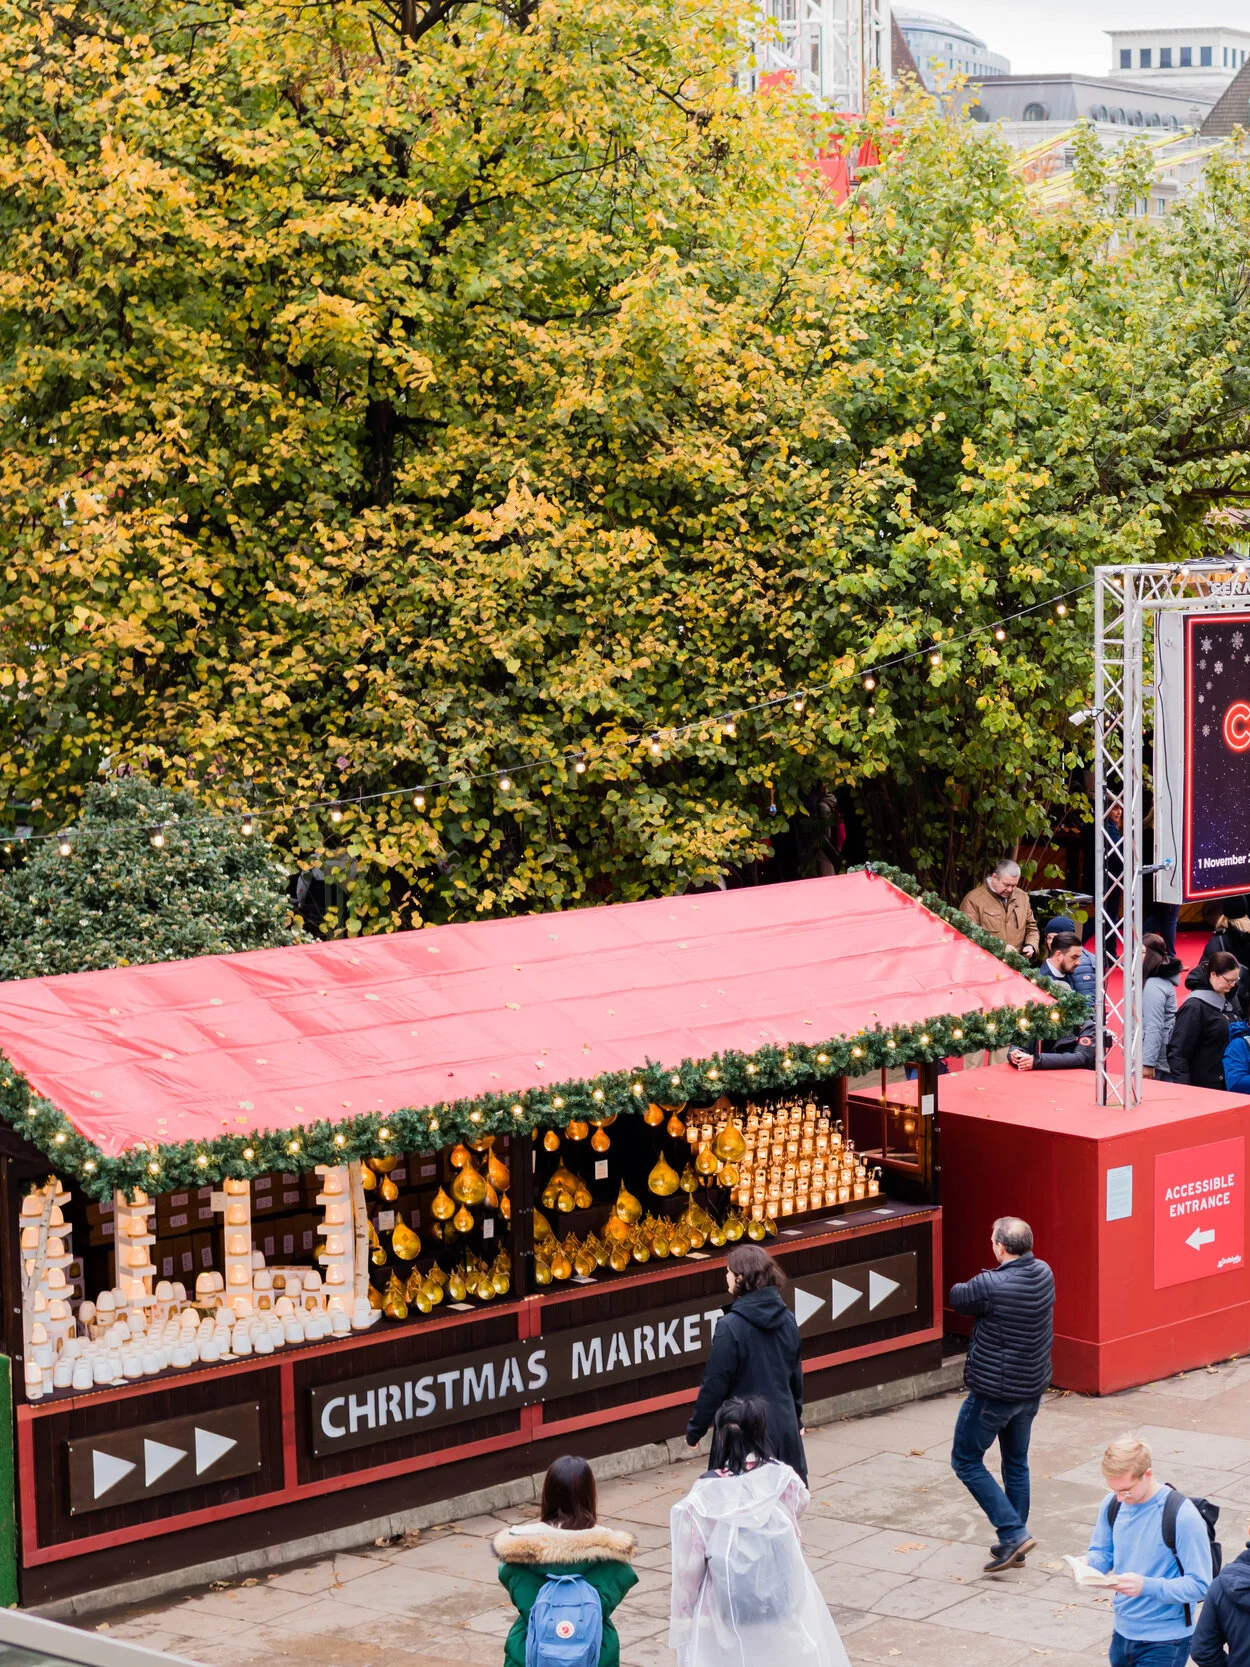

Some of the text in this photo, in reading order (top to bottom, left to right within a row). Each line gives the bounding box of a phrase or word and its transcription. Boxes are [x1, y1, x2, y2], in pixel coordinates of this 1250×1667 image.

[1198, 858, 1203, 869] 1
[1203, 854, 1247, 869] November
[1165, 1173, 1235, 1201] ACCESSIBLE
[1169, 1192, 1231, 1218] ENTRANCE
[320, 1308, 726, 1439] CHRISTMAS MARKET
